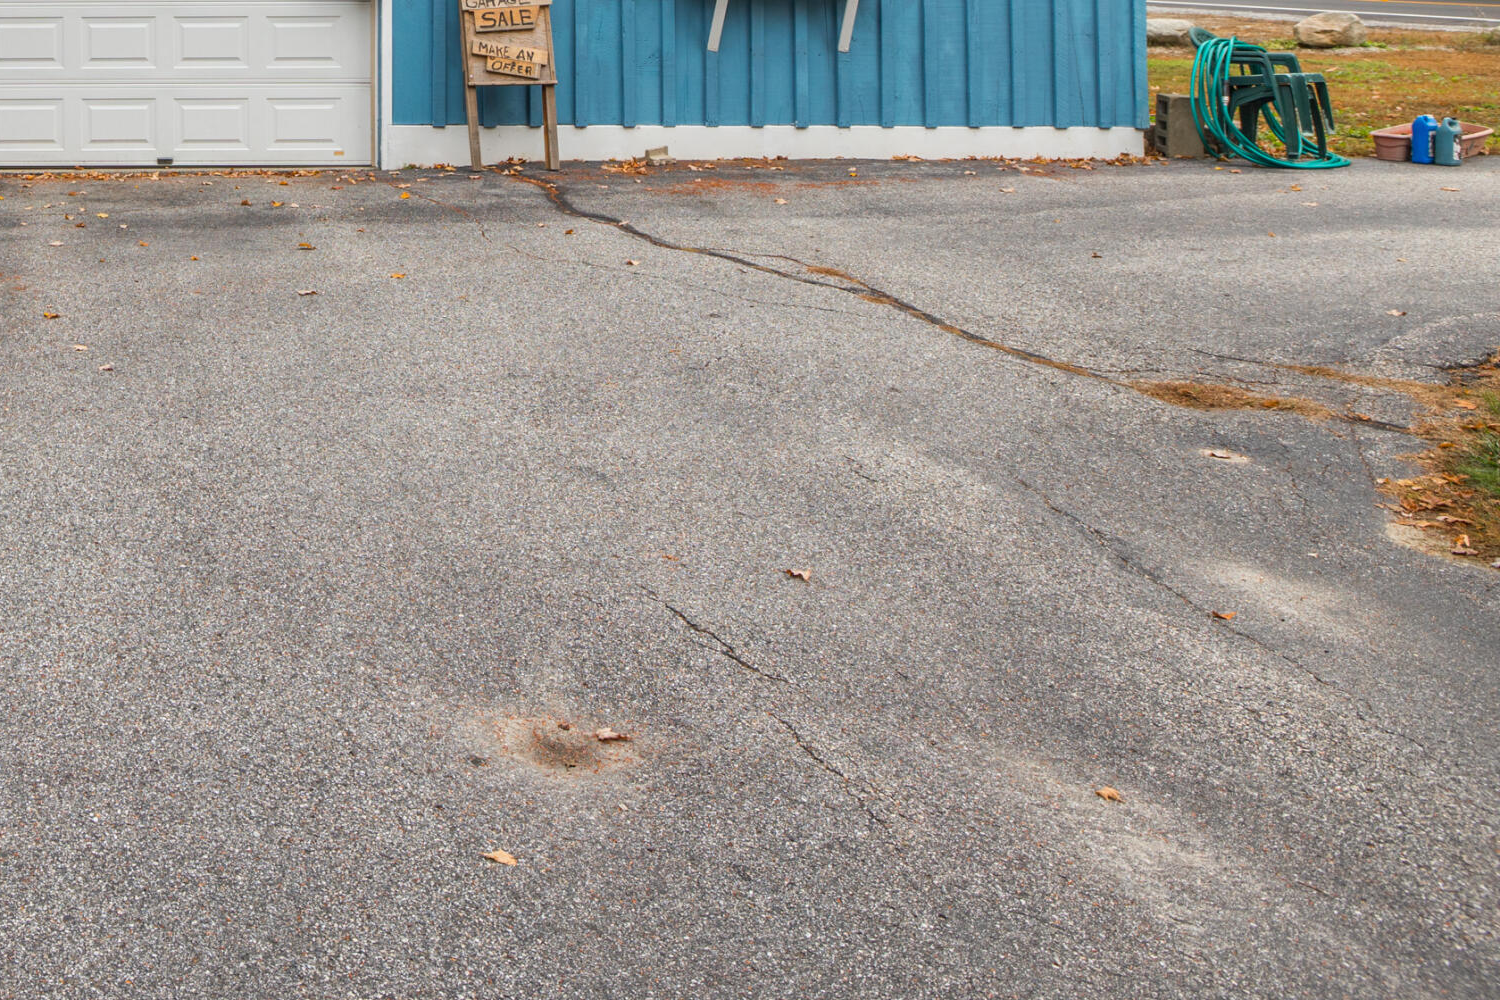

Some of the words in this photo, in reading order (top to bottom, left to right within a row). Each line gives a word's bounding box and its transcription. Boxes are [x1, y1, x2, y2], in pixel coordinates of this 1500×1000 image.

[480, 9, 534, 28] SALE
[478, 41, 510, 58] MAKE
[516, 49, 534, 62] AN
[491, 61, 533, 76] OFFER
